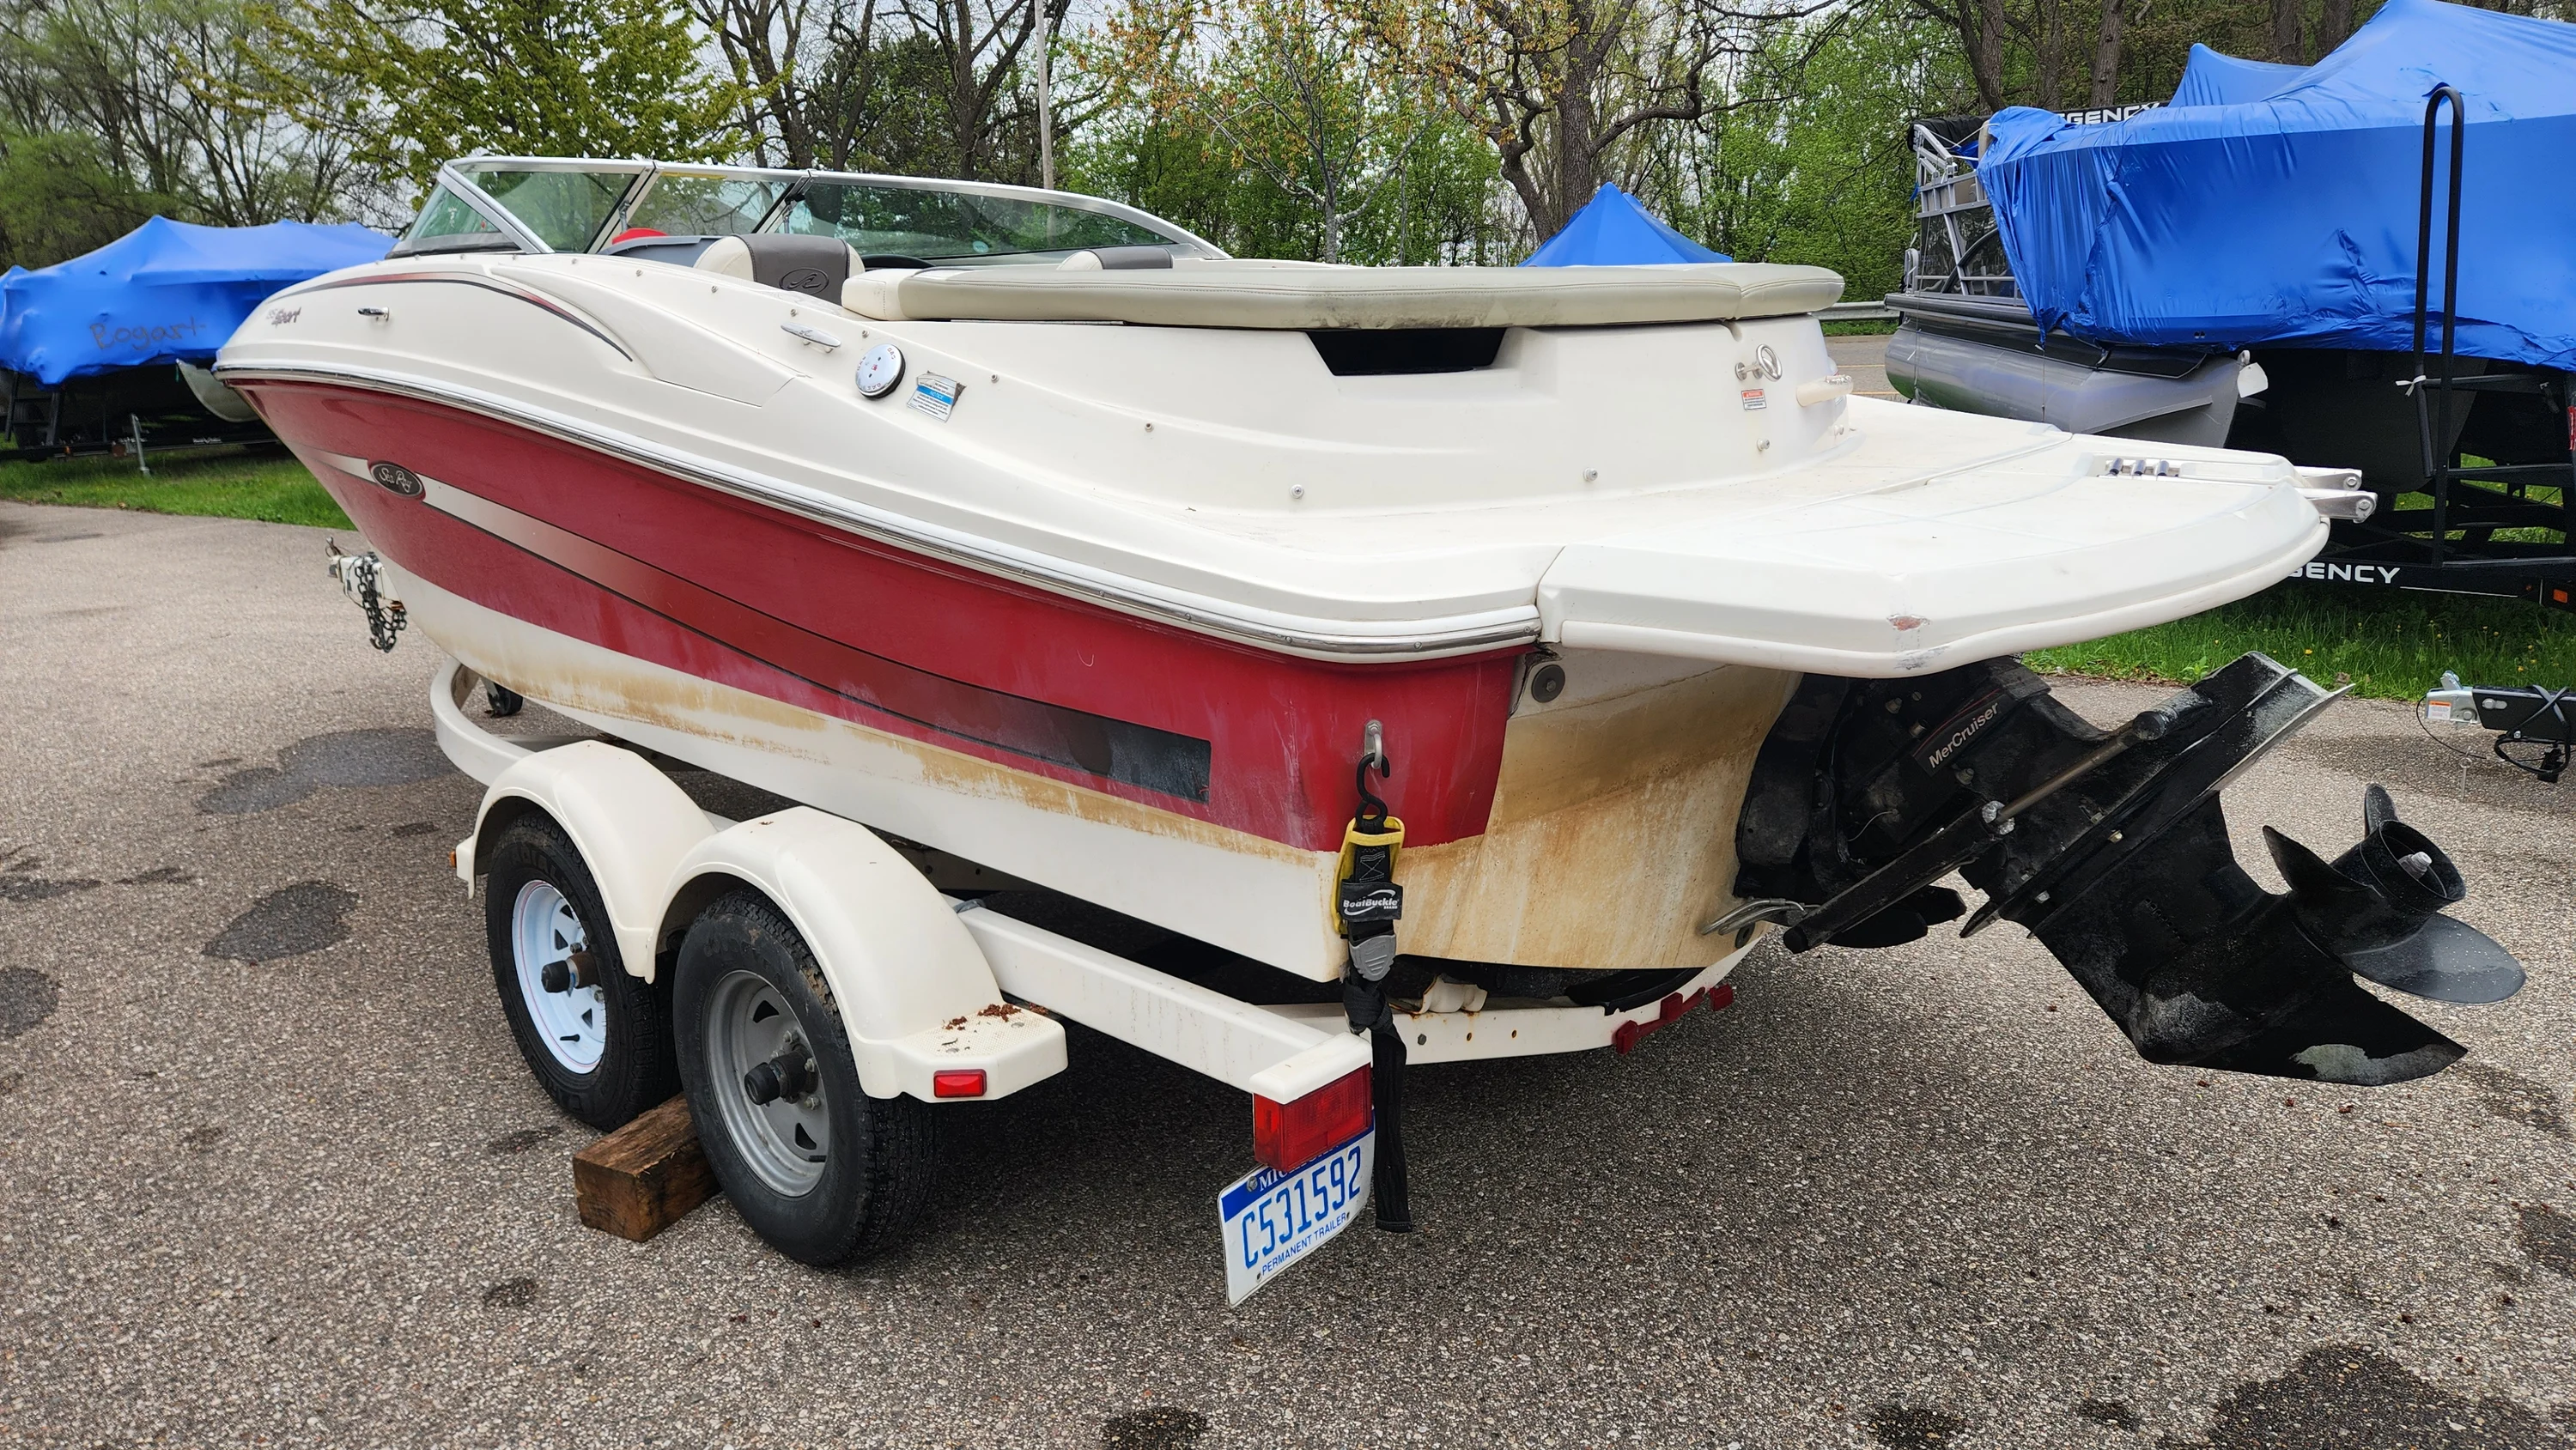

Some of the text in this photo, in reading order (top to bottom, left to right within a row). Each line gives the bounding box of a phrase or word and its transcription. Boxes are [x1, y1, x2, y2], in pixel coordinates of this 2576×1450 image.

[379, 467, 412, 493] Sea Ray
[2287, 562, 2401, 584] ENCY
[1929, 702, 1998, 768] MerCruiser
[1343, 898, 1398, 907] BoatBuckle
[1242, 1145, 1361, 1270] C531592
[1262, 1212, 1347, 1276] PERMANENT TRAILER
